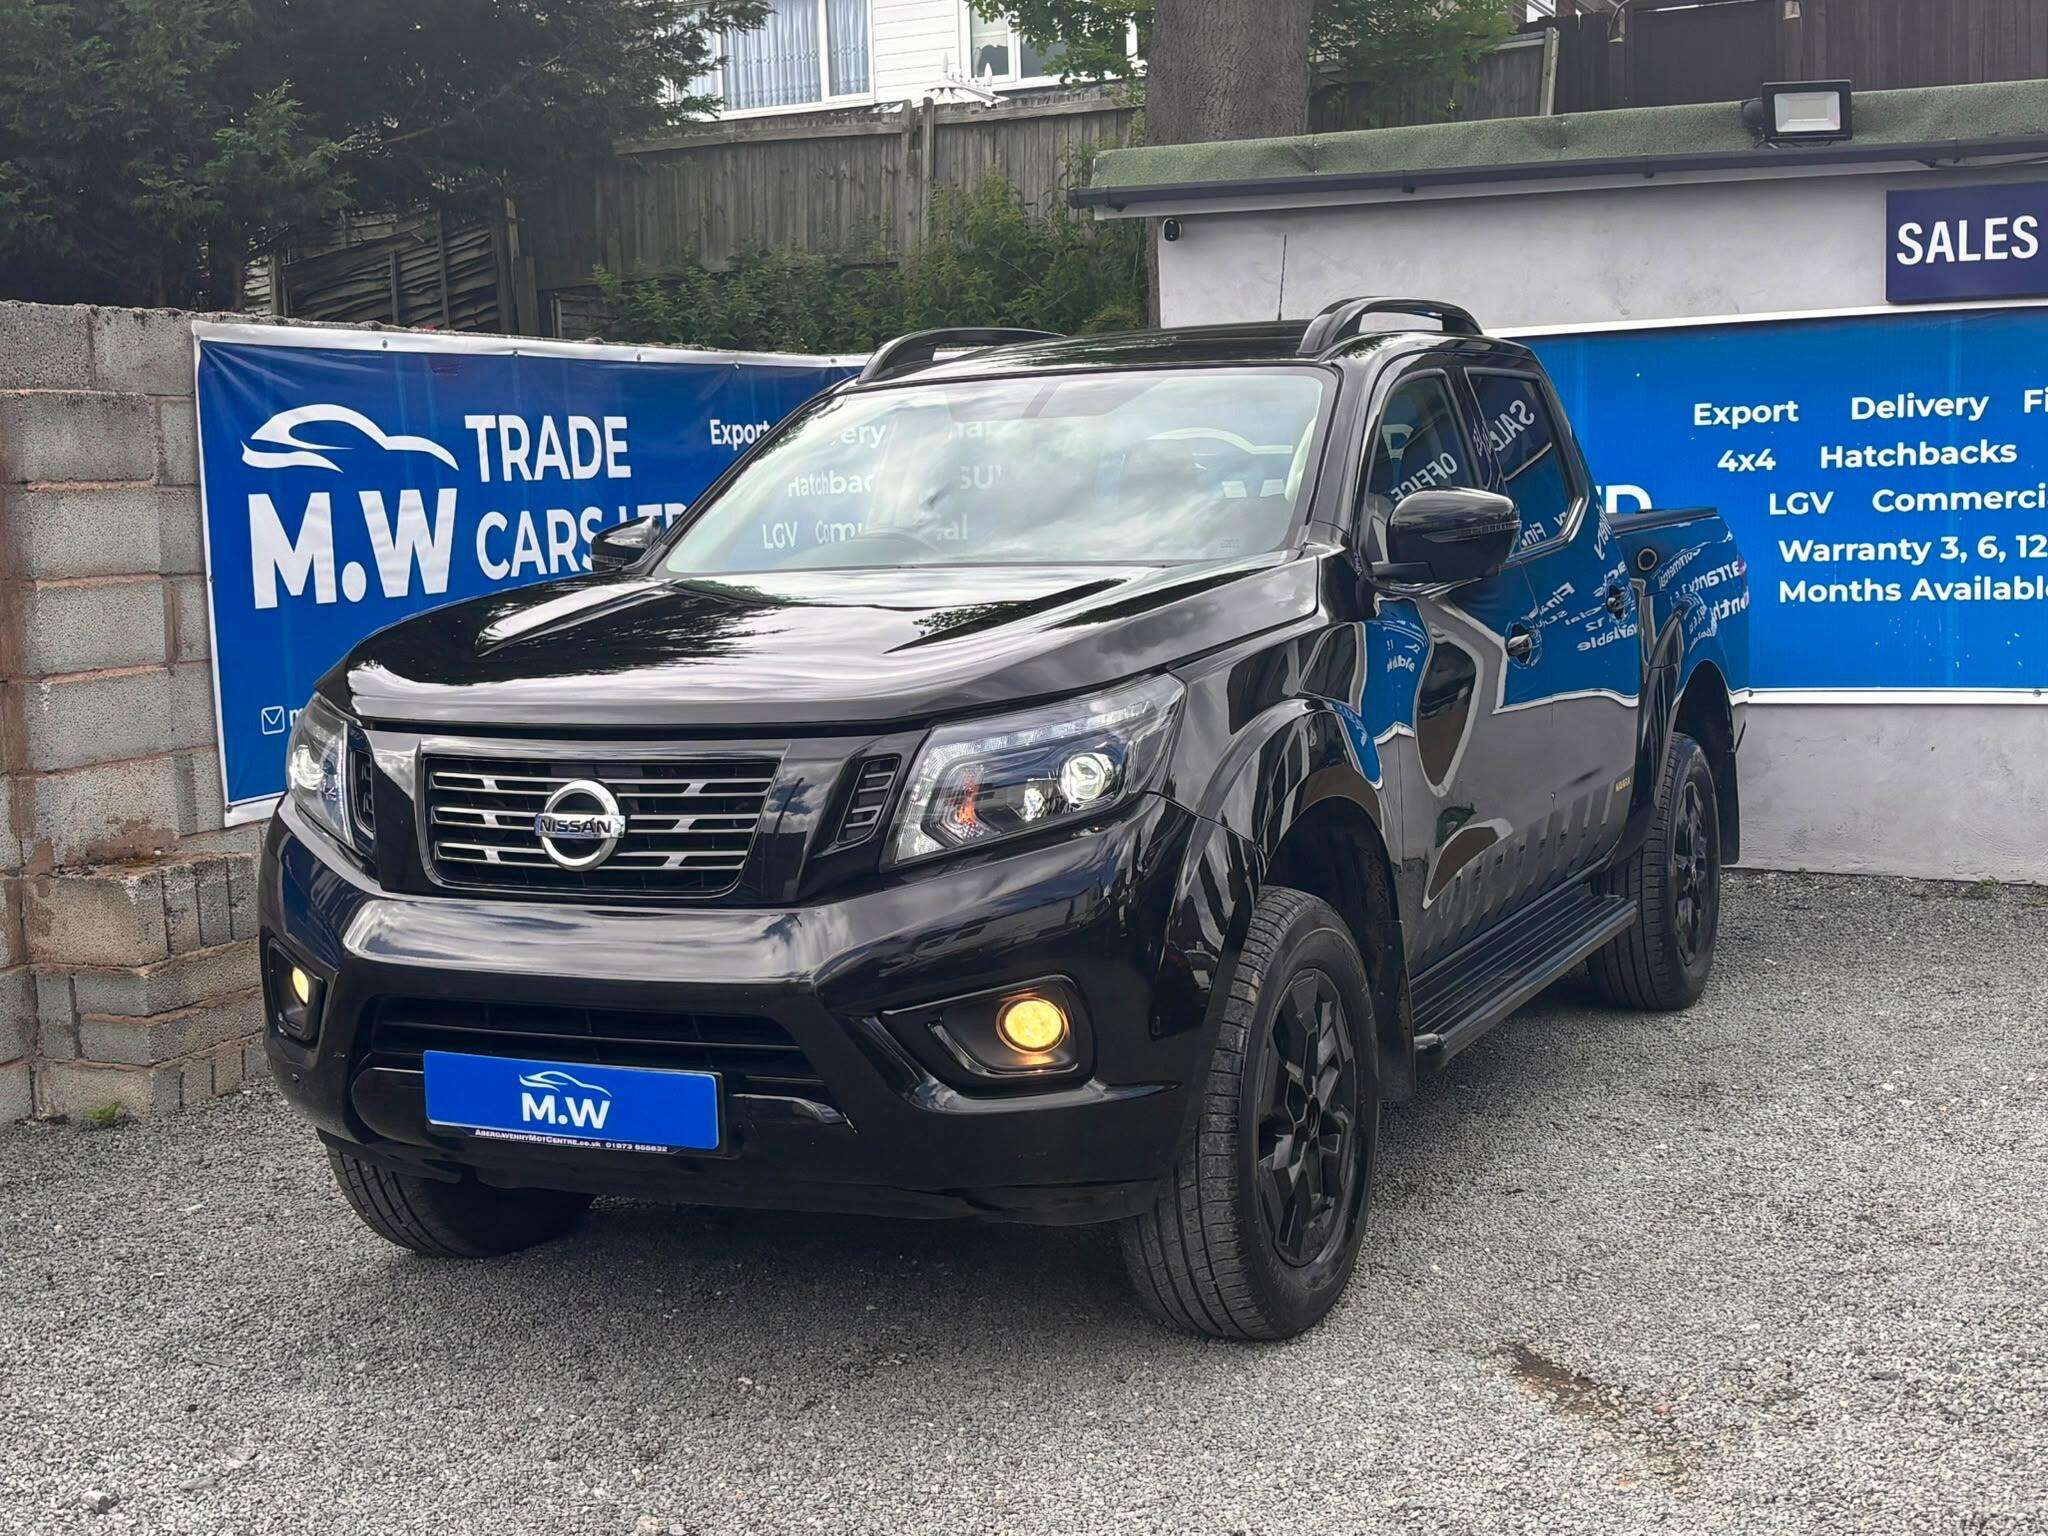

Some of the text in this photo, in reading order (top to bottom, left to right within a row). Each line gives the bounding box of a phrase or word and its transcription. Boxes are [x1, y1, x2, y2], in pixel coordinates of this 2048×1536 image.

[1896, 215, 2039, 266] SALES
[1694, 400, 1799, 429] Export
[1851, 393, 1990, 421] Delivery
[464, 414, 632, 483] TRADE
[1717, 438, 2018, 472] 4x4 Hatchbacks
[1769, 482, 2048, 515] LGV Commerci
[247, 487, 458, 610] M.W
[762, 521, 798, 550] LGV
[1778, 539, 1932, 566] Warranty
[1940, 536, 1968, 563] 3,
[1977, 535, 2007, 563] 6,
[1779, 575, 2048, 603] Months Availabl
[540, 817, 612, 834] NISSAN
[520, 1091, 611, 1130] M.W
